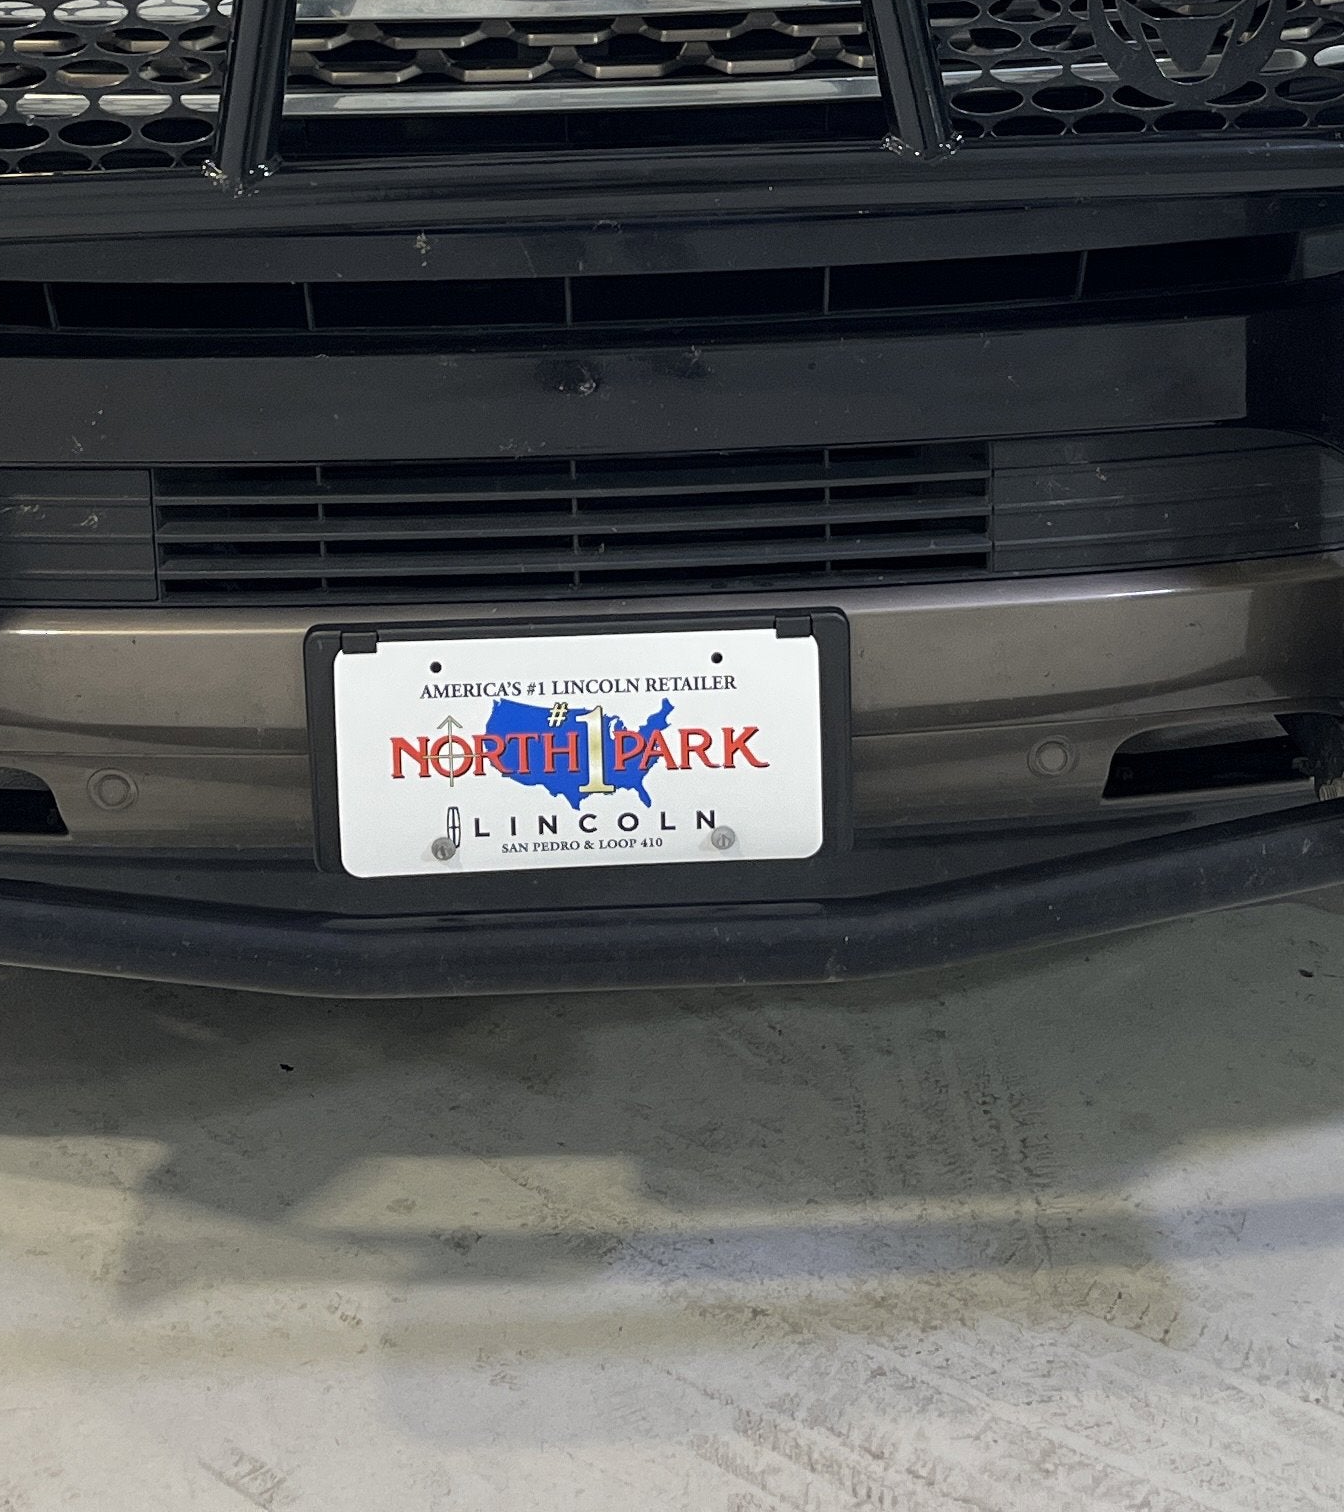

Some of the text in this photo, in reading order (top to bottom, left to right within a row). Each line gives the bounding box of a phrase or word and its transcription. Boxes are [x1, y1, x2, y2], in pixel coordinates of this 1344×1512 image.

[526, 681, 546, 695] #1
[551, 677, 640, 695] LINCOLN
[645, 675, 737, 692] RETAILER
[389, 726, 771, 779] NORTH PARK
[474, 809, 717, 838] LINCOLN
[501, 837, 663, 854] SAN PEDRO & LOOP 410
